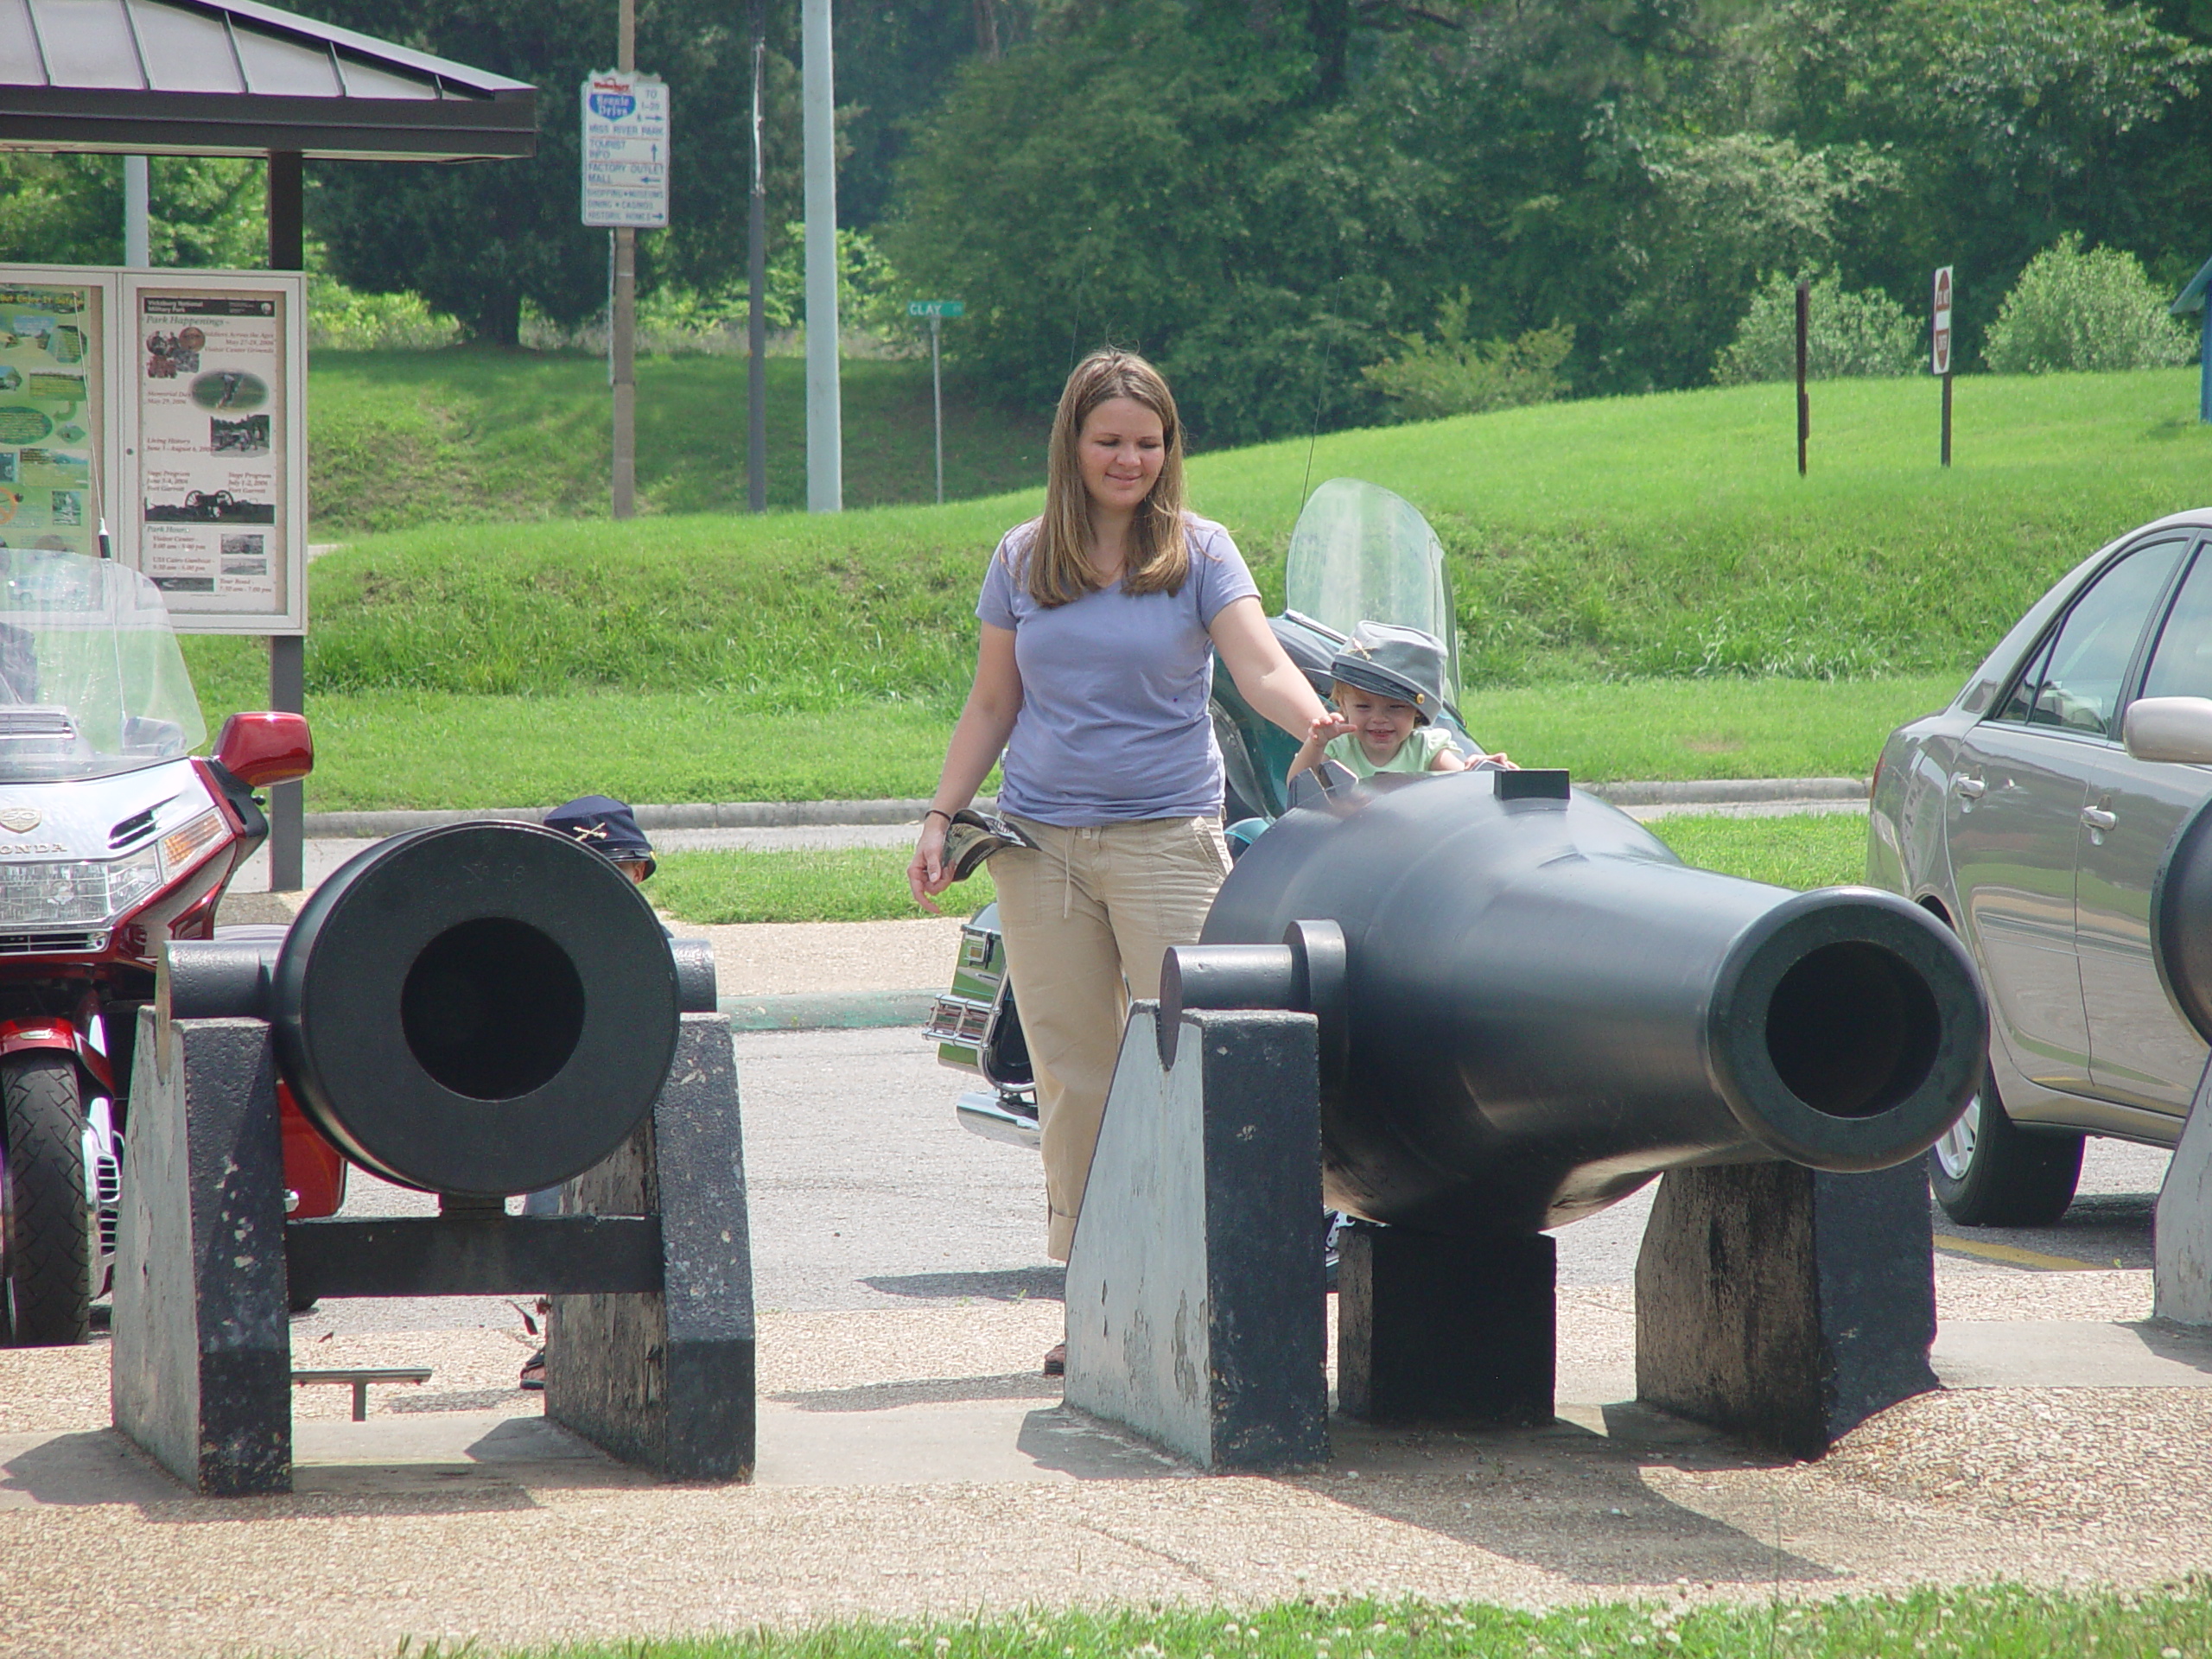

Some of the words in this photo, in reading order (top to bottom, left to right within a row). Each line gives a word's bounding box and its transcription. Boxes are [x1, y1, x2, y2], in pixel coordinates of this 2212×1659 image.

[646, 89, 658, 99] TO
[599, 105, 628, 117] Drive
[613, 125, 639, 136] RIVER
[641, 126, 664, 137] PARK
[588, 139, 626, 149] TOURIST
[588, 149, 611, 159] INFO
[588, 162, 626, 172] FACTORY
[630, 164, 664, 175] OUTLET
[588, 174, 612, 184] MALL
[910, 303, 942, 316] CLAY
[146, 315, 168, 324] Park
[170, 316, 224, 327] Happenings
[0, 843, 67, 855] ONDA
